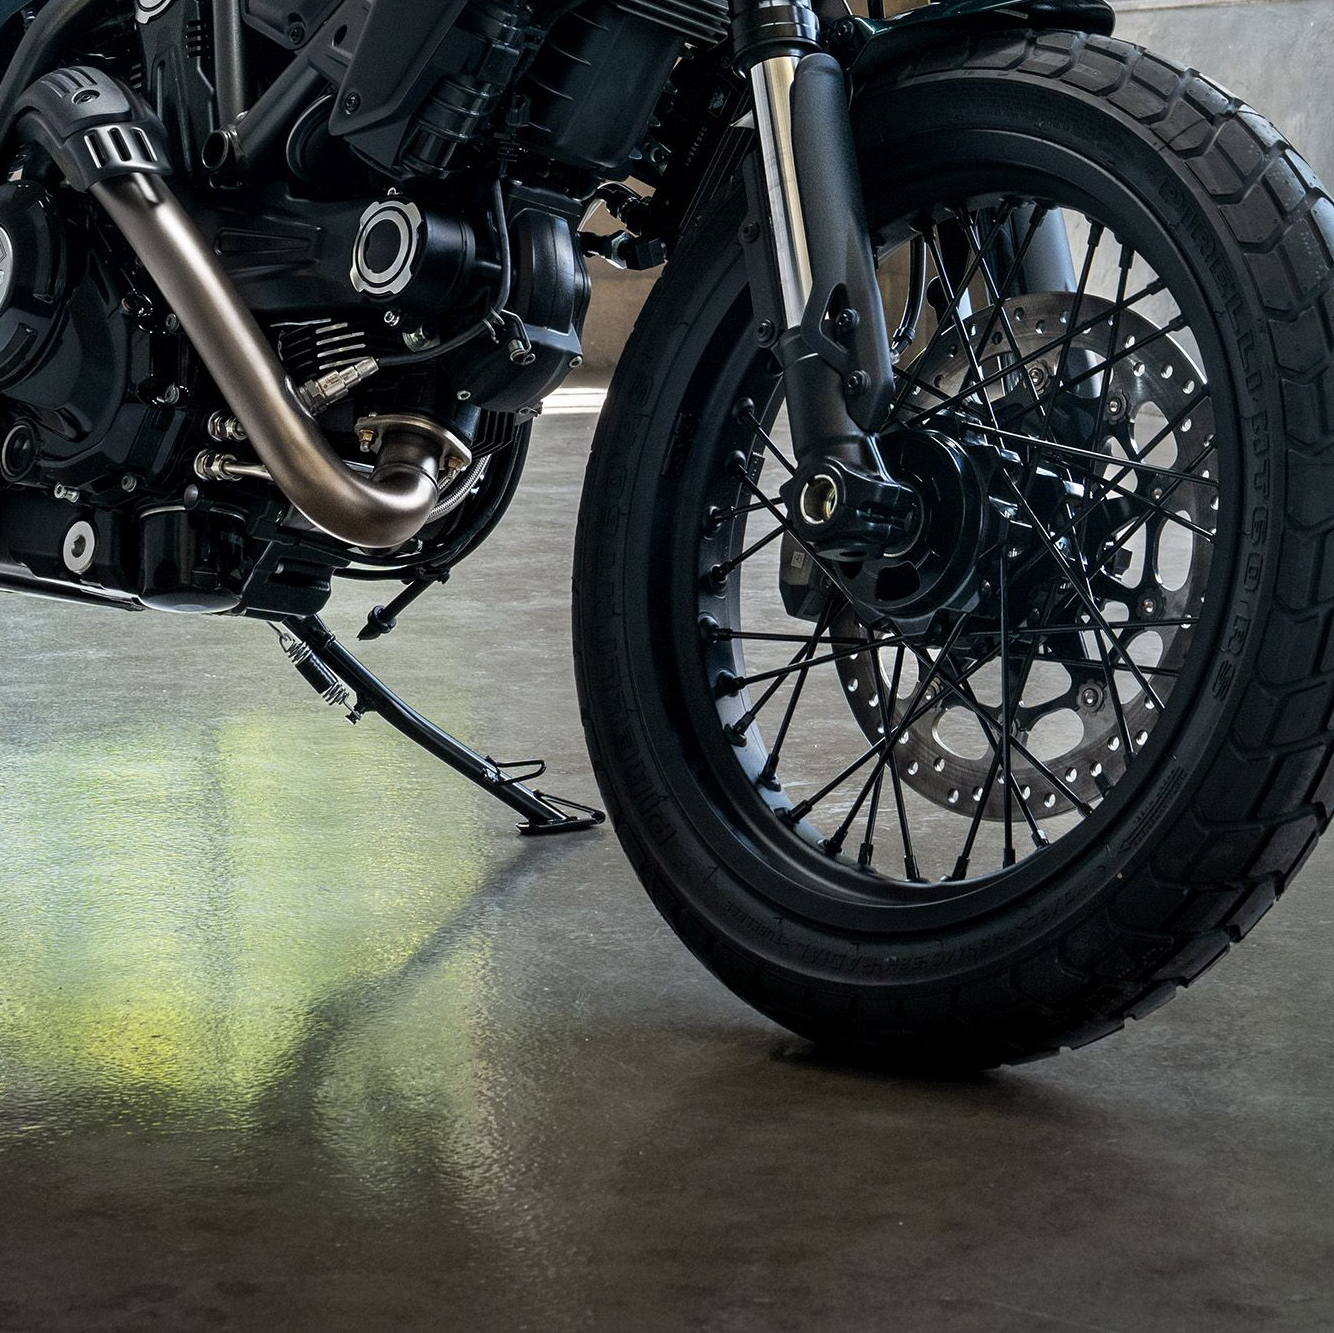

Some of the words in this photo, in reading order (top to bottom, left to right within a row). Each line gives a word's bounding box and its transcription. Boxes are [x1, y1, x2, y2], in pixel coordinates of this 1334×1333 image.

[1157, 173, 1265, 395] PIRELLI
[1242, 408, 1271, 594] MT60
[1210, 613, 1251, 703] RS
